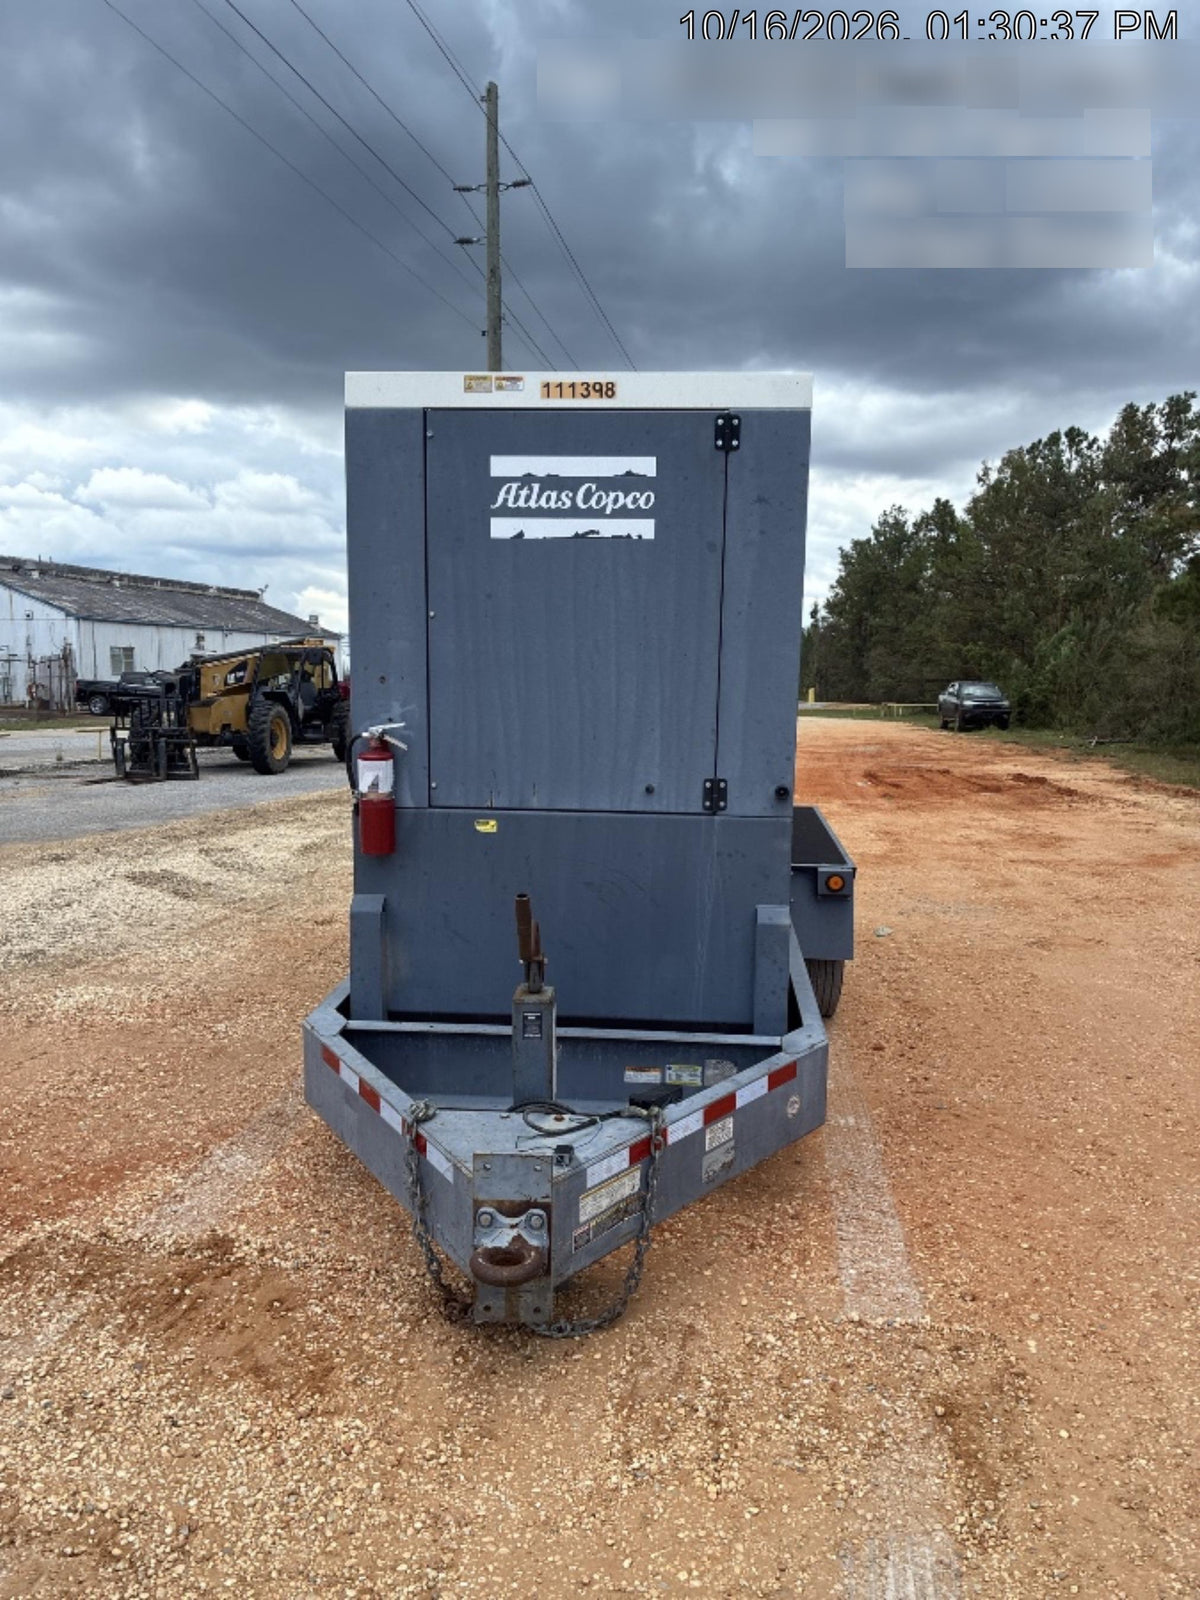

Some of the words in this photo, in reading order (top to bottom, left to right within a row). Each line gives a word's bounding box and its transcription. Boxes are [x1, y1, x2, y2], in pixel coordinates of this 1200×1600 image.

[543, 381, 616, 399] 111398
[490, 482, 572, 509] Atlas
[575, 483, 655, 514] Copco
